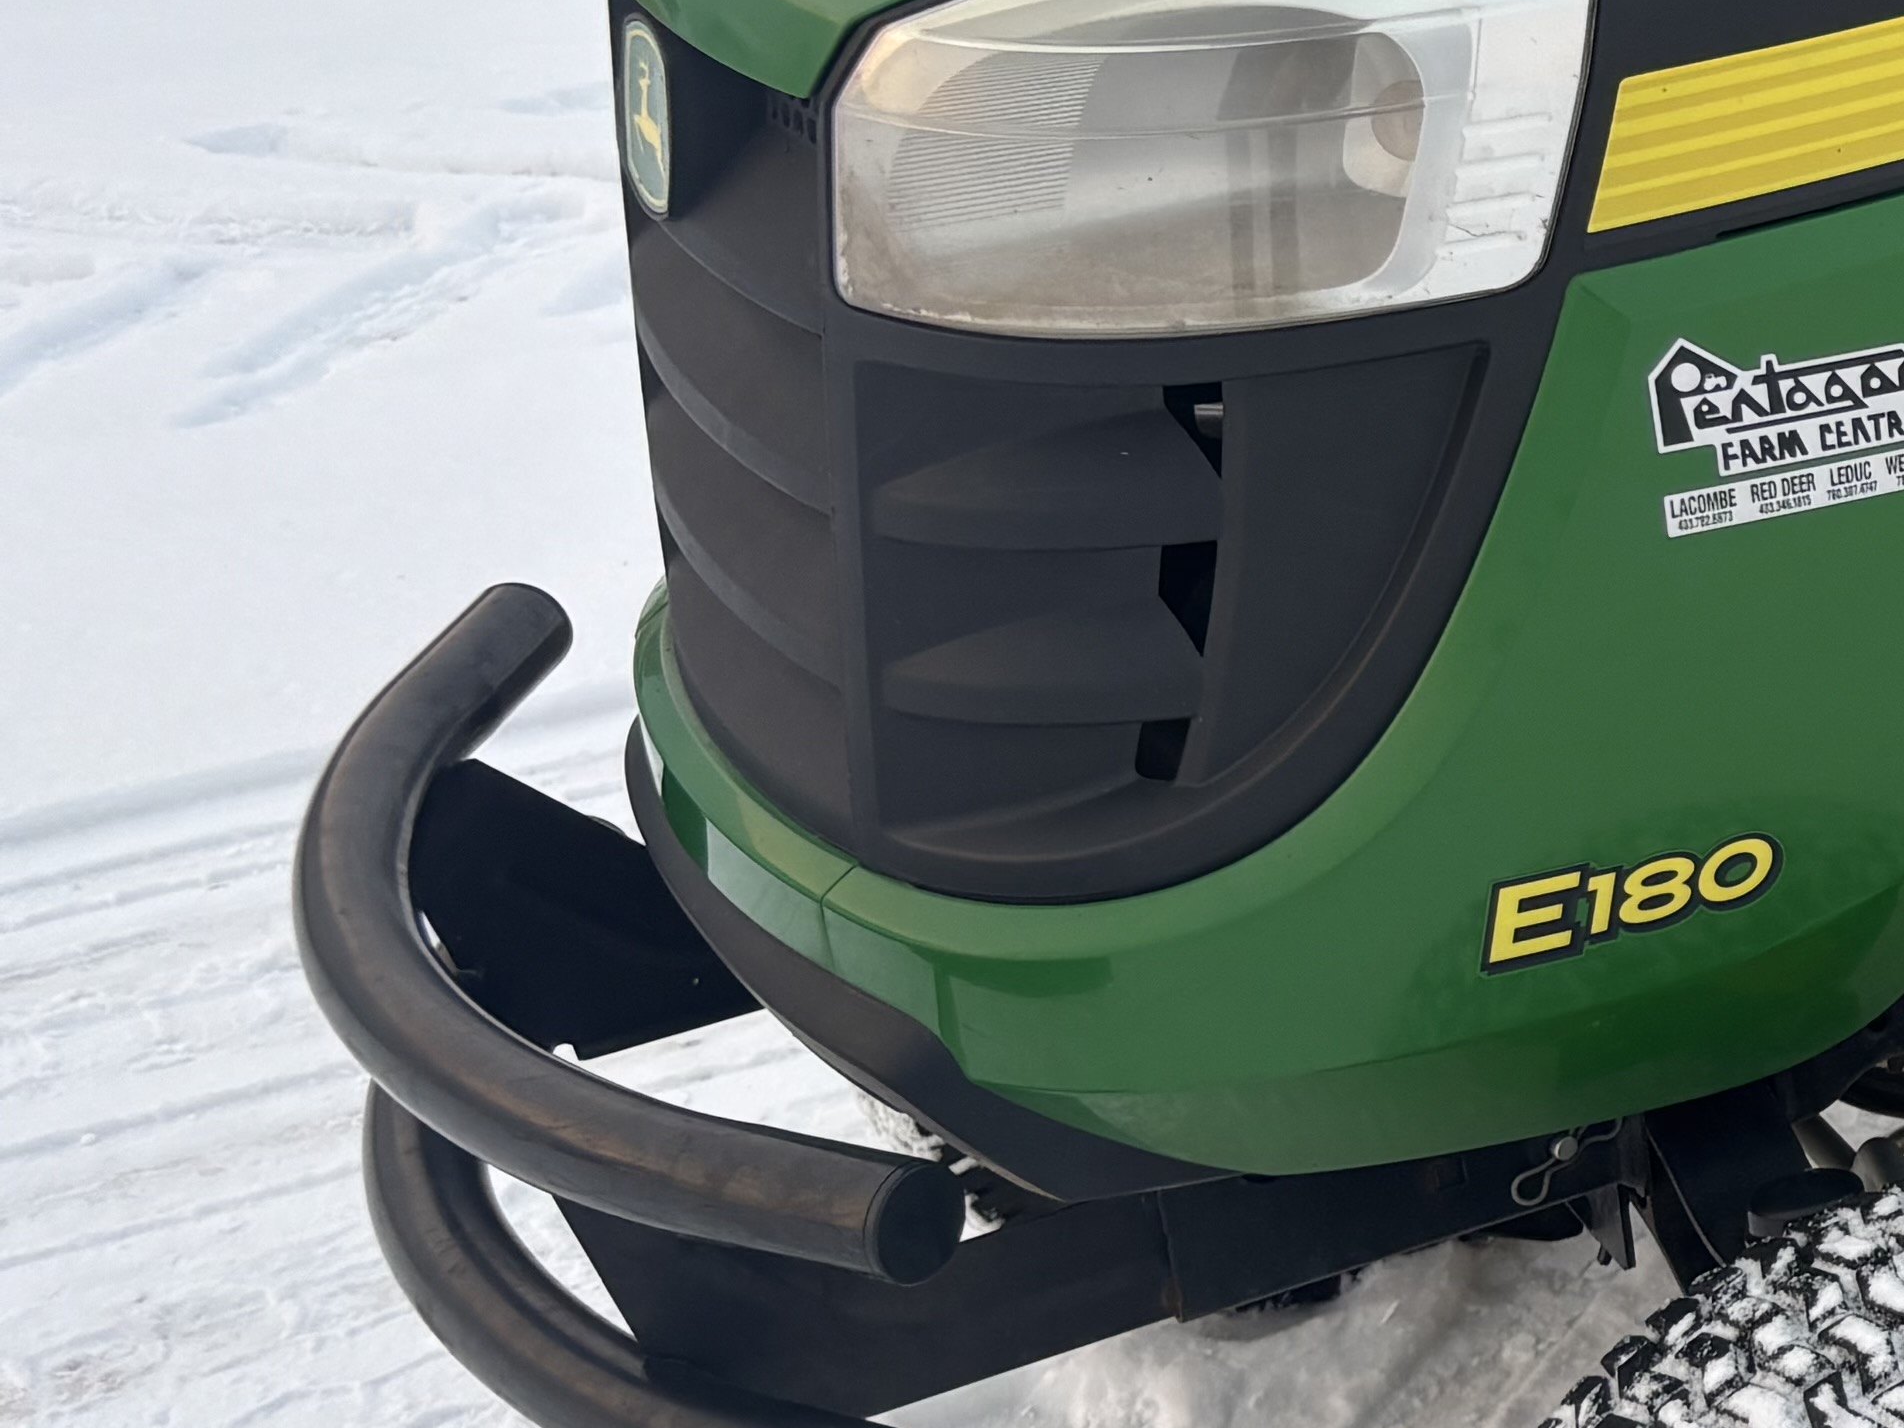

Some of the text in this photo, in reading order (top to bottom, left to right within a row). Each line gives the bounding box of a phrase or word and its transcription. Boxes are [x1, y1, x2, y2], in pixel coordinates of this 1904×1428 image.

[1720, 428, 1809, 471] FARM
[1669, 488, 1737, 518] LACOMBE
[1750, 478, 1778, 503] RED
[1781, 473, 1816, 499] DEER
[1829, 461, 1872, 486] LEDUC
[1486, 835, 1776, 967] E180
